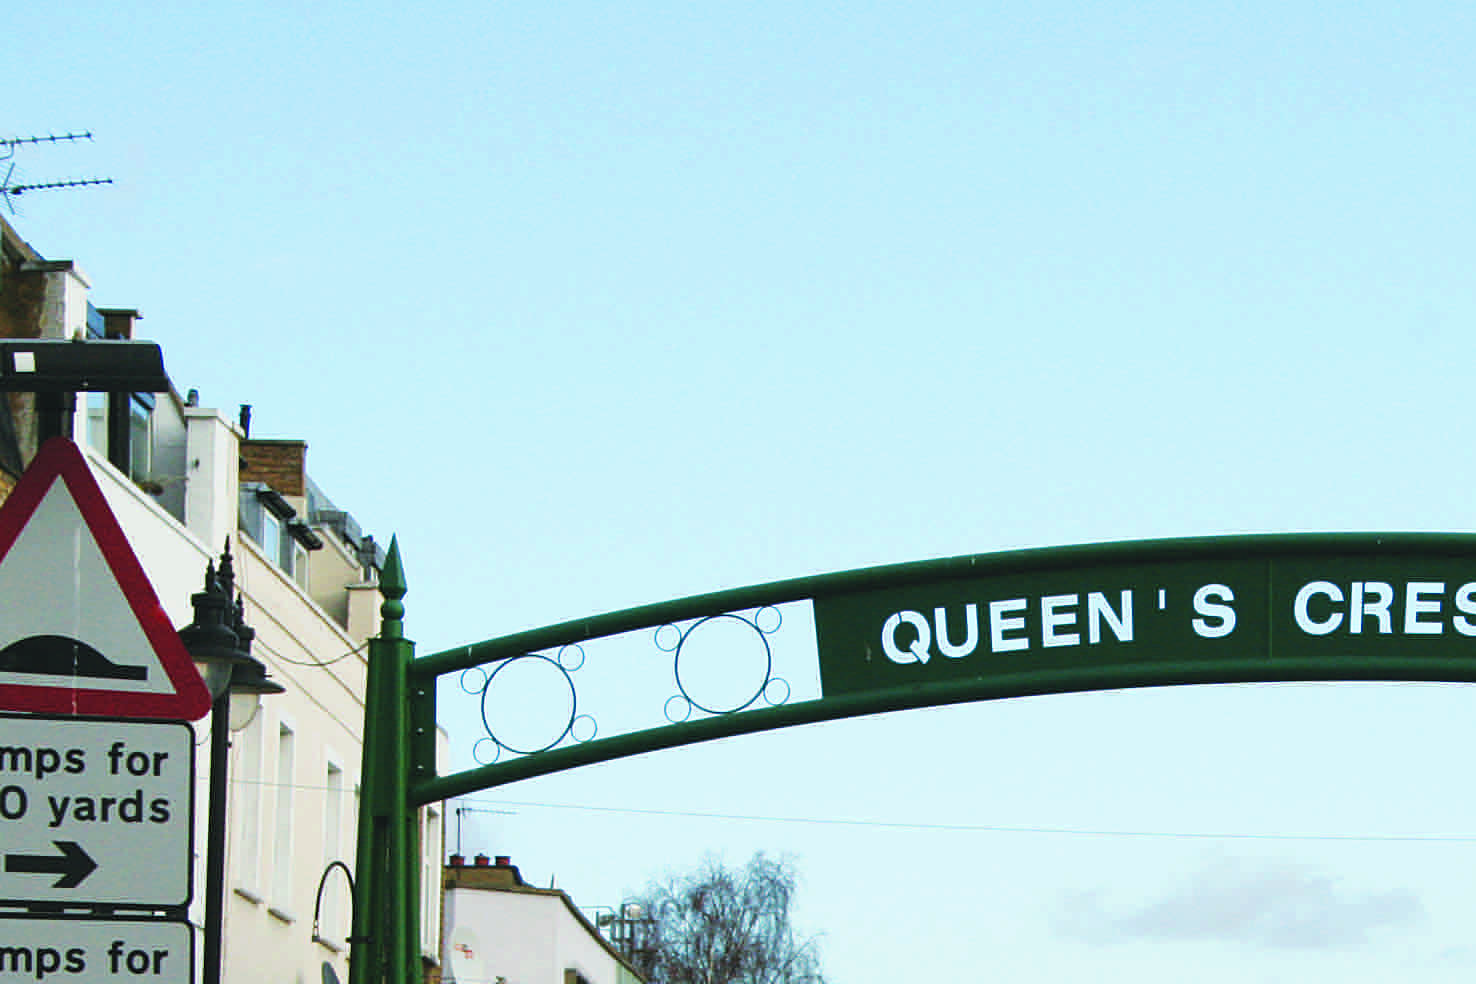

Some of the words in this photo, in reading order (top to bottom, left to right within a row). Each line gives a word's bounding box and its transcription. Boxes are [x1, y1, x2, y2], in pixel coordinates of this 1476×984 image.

[107, 741, 169, 777] for
[48, 789, 171, 828] yards
[107, 940, 169, 975] for
